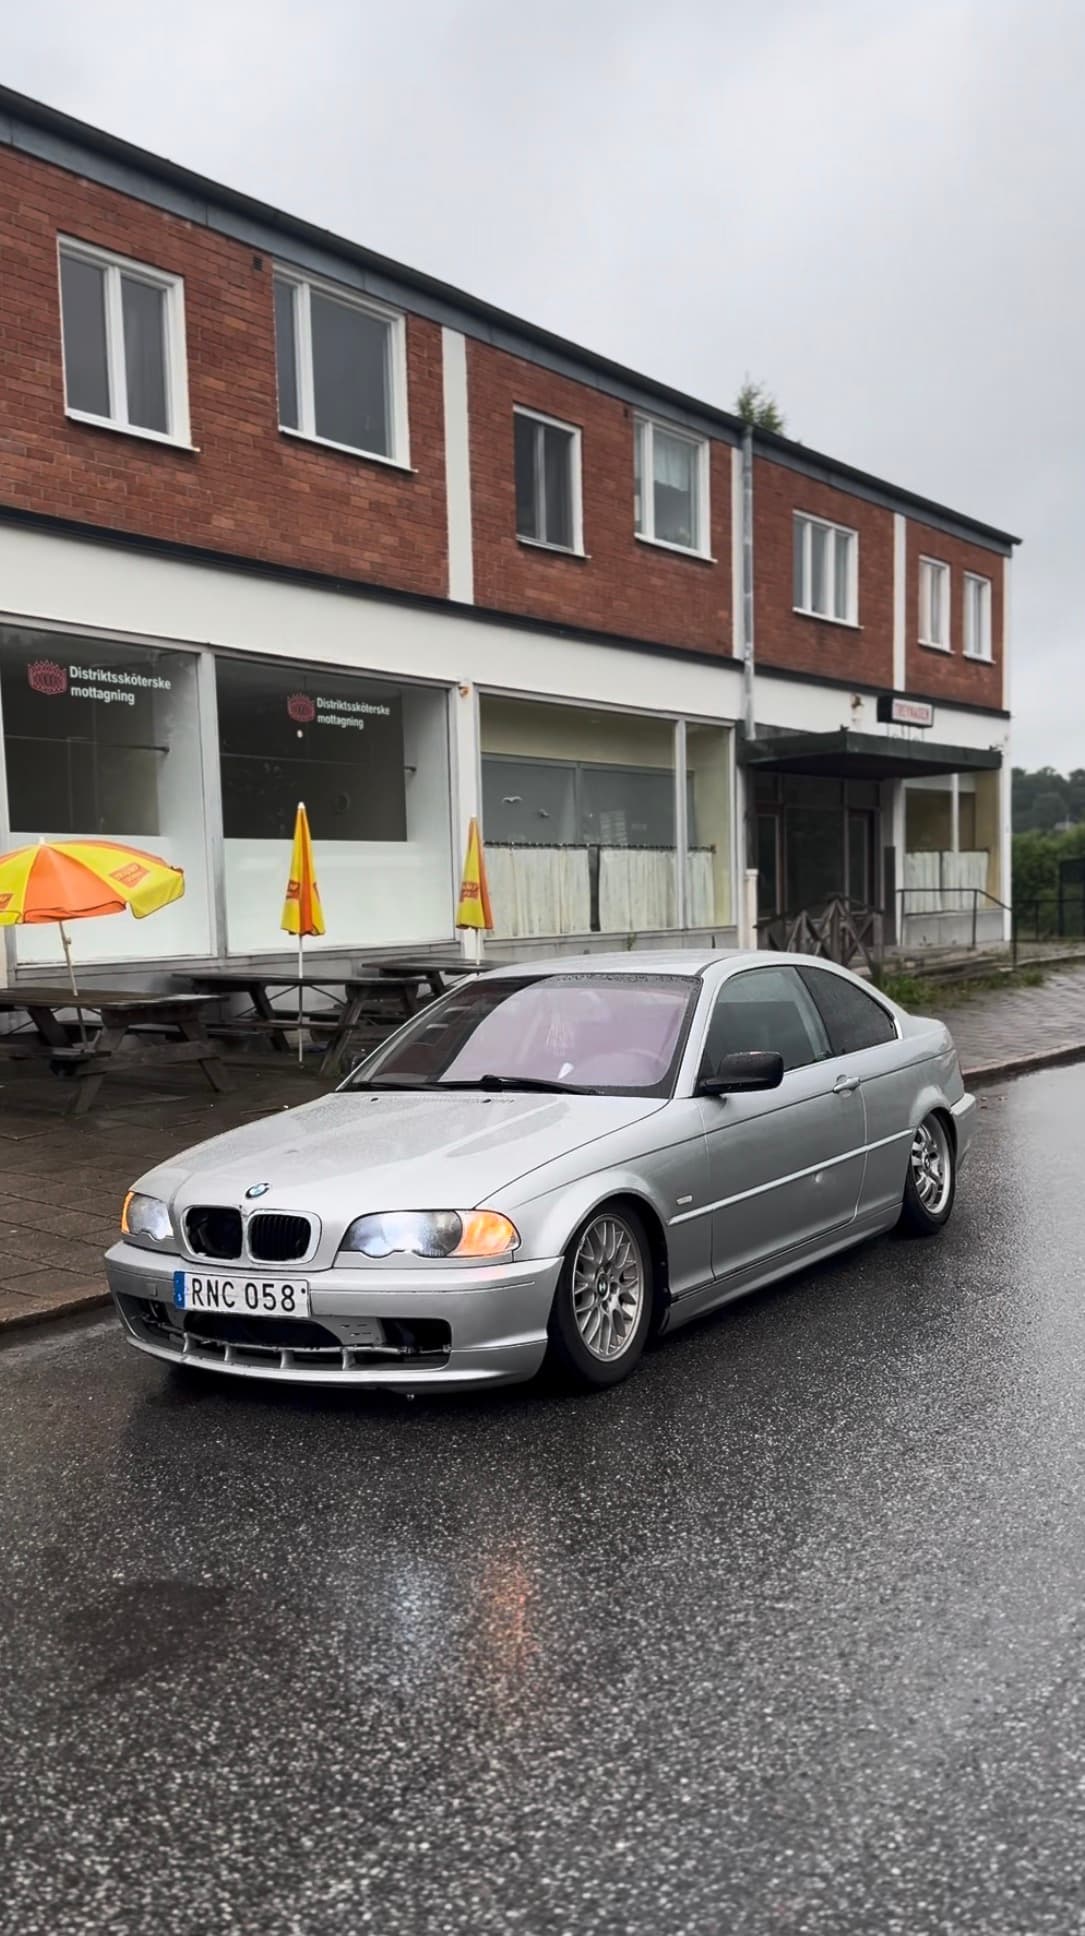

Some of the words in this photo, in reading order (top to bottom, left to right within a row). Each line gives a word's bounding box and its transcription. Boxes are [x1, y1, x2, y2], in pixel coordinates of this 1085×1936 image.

[69, 665, 172, 690] Distriktssköterske
[70, 686, 136, 706] mottagning
[316, 696, 391, 716] Distriktssköterske
[317, 714, 365, 731] mottagning
[192, 1278, 236, 1308] RNC
[244, 1282, 296, 1312] 058
